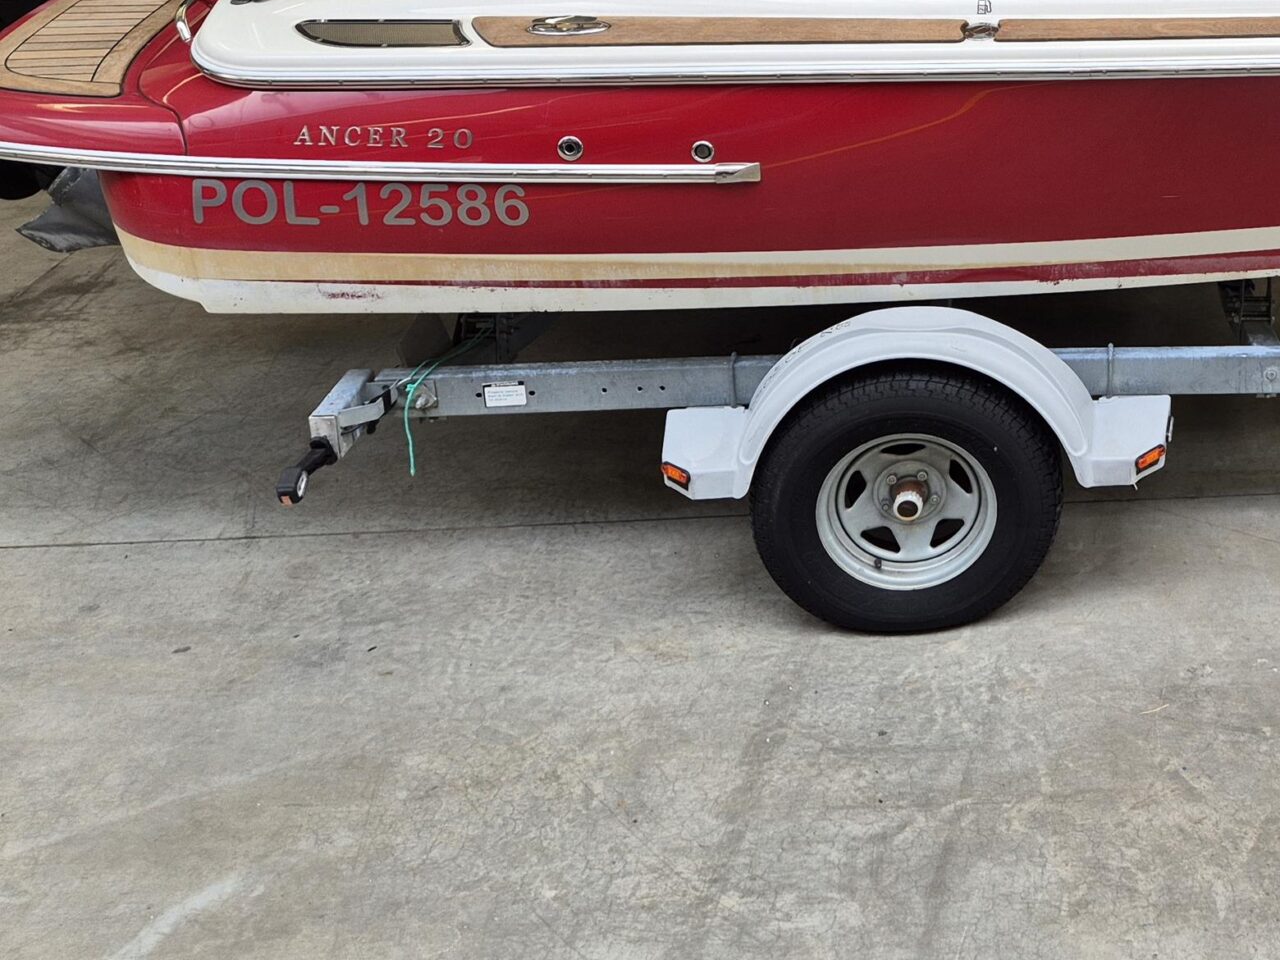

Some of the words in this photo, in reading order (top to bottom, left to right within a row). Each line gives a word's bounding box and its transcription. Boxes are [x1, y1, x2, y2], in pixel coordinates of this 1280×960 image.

[293, 125, 409, 149] ANCER
[426, 127, 475, 150] 20
[191, 178, 531, 227] POL-12586
